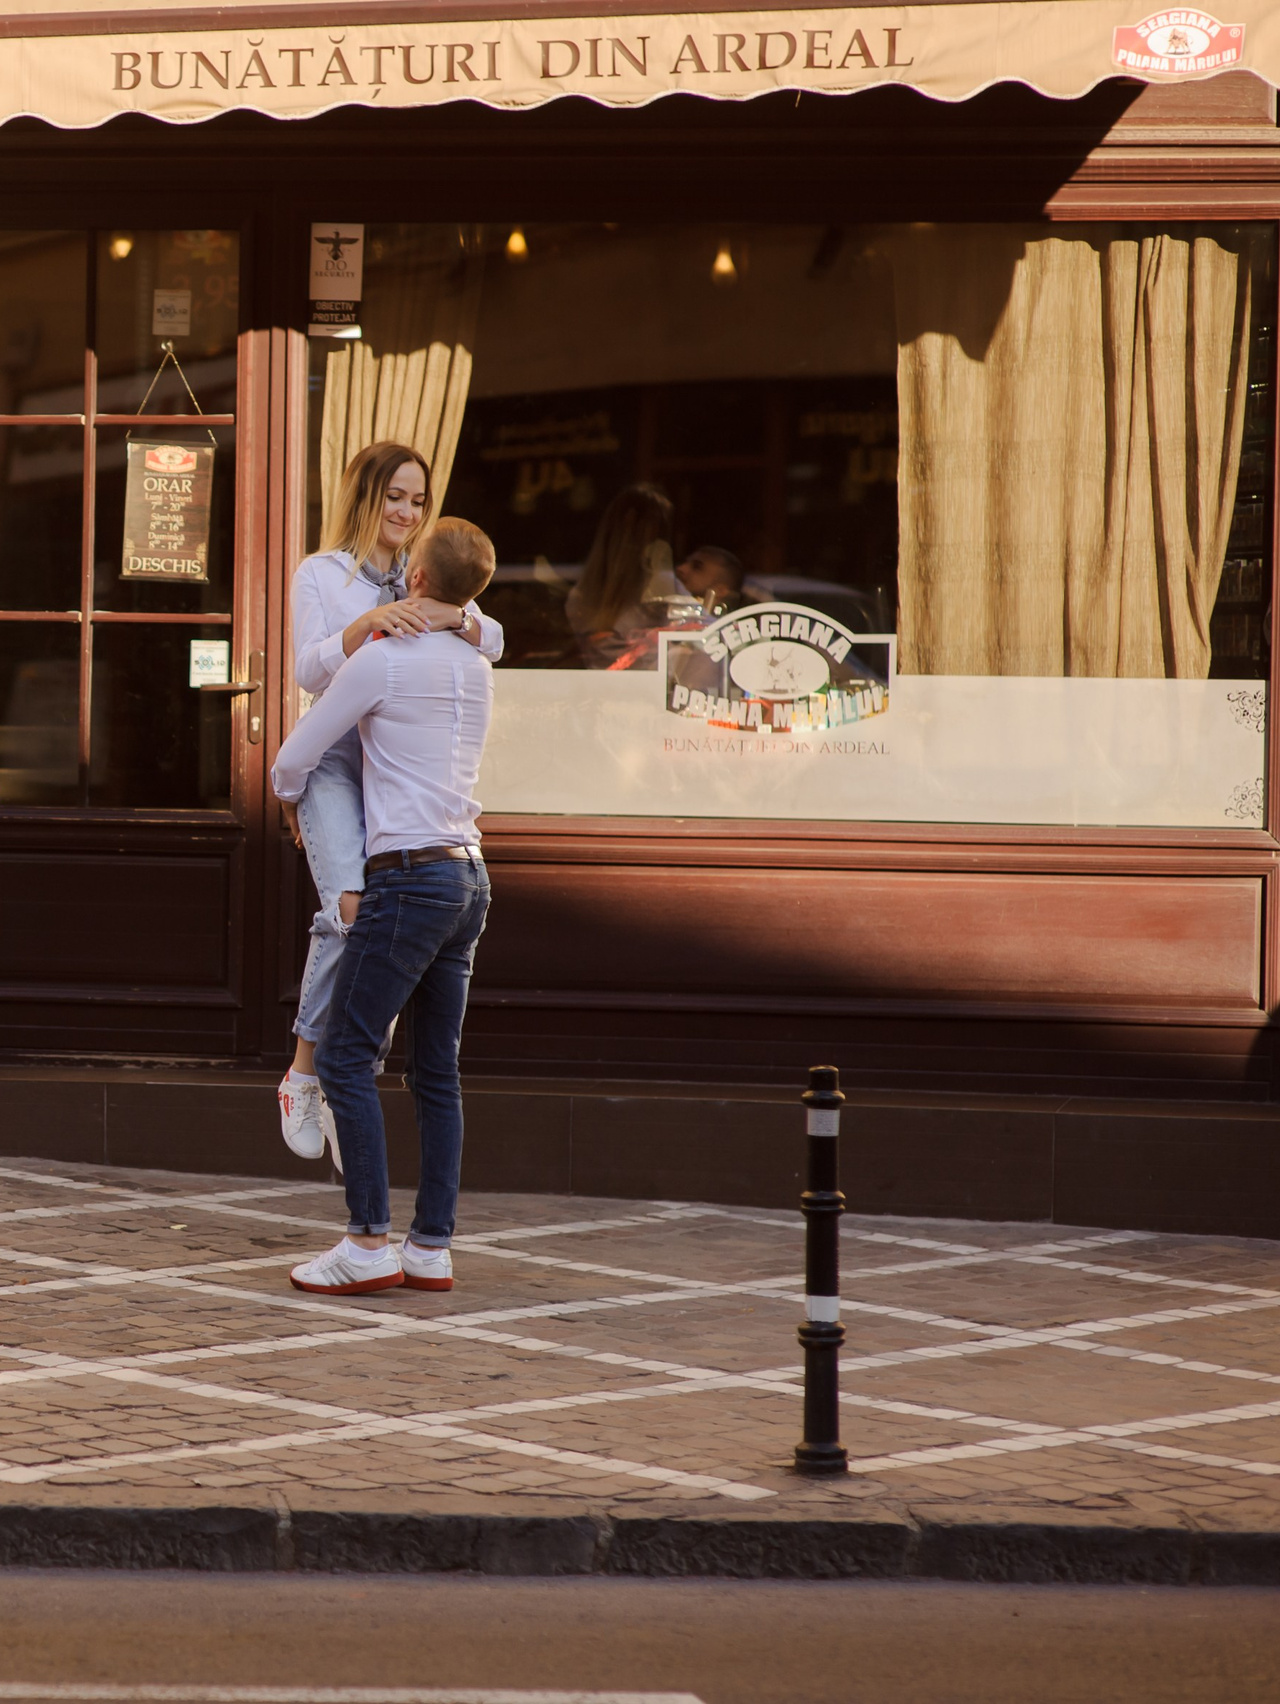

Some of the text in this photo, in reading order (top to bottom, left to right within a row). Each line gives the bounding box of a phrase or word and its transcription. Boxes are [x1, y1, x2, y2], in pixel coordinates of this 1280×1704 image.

[1136, 12, 1222, 38] SERGIANA
[110, 27, 915, 99] BUNĂTĂȚURI DIN ARDEAL
[1117, 48, 1170, 71] POIANA
[315, 301, 354, 311] OBIECTIV
[313, 312, 356, 322] PROTEJAT
[143, 477, 192, 493] ORAR
[128, 556, 202, 573] DESCHIS
[702, 613, 852, 664] SERGIANA
[672, 684, 763, 728] POIANA
[819, 740, 890, 755] ARDEAL
